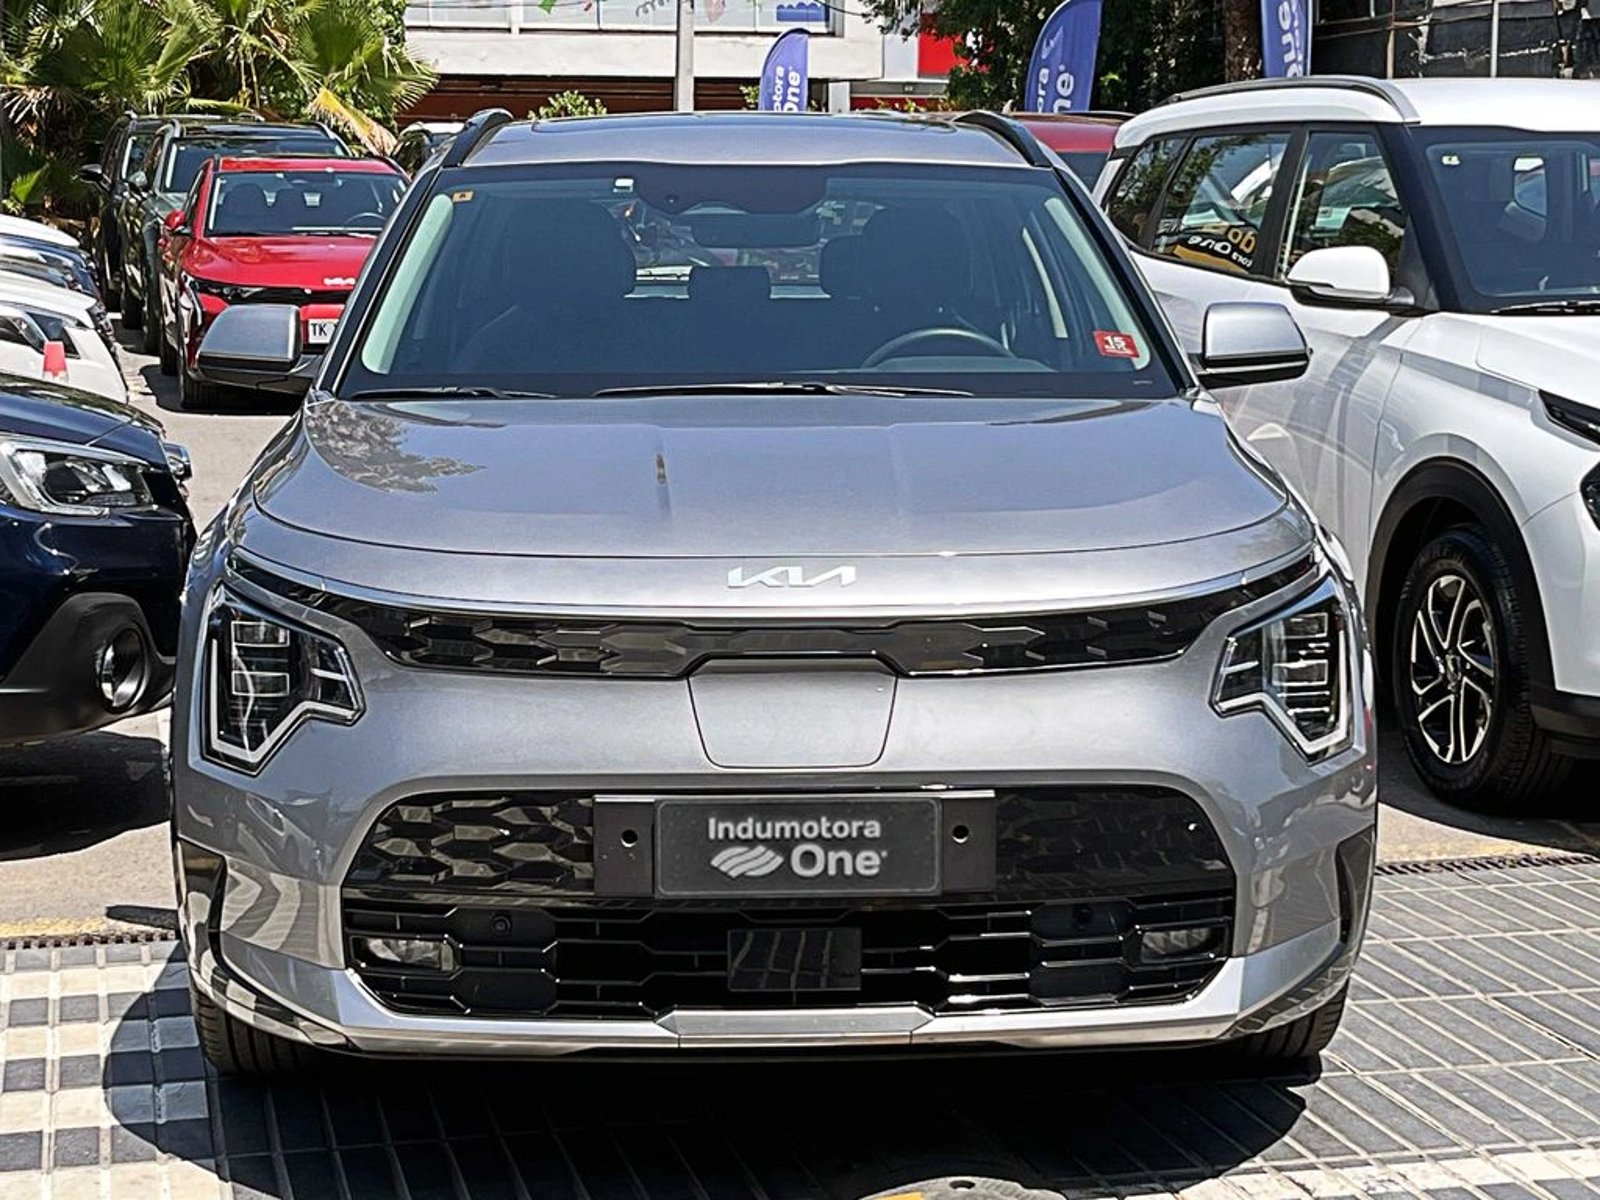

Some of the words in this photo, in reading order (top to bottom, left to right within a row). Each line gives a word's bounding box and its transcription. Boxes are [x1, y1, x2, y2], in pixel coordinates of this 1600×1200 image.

[728, 565, 856, 588] KIA
[708, 816, 881, 840] Indumotora
[790, 843, 881, 877] One
